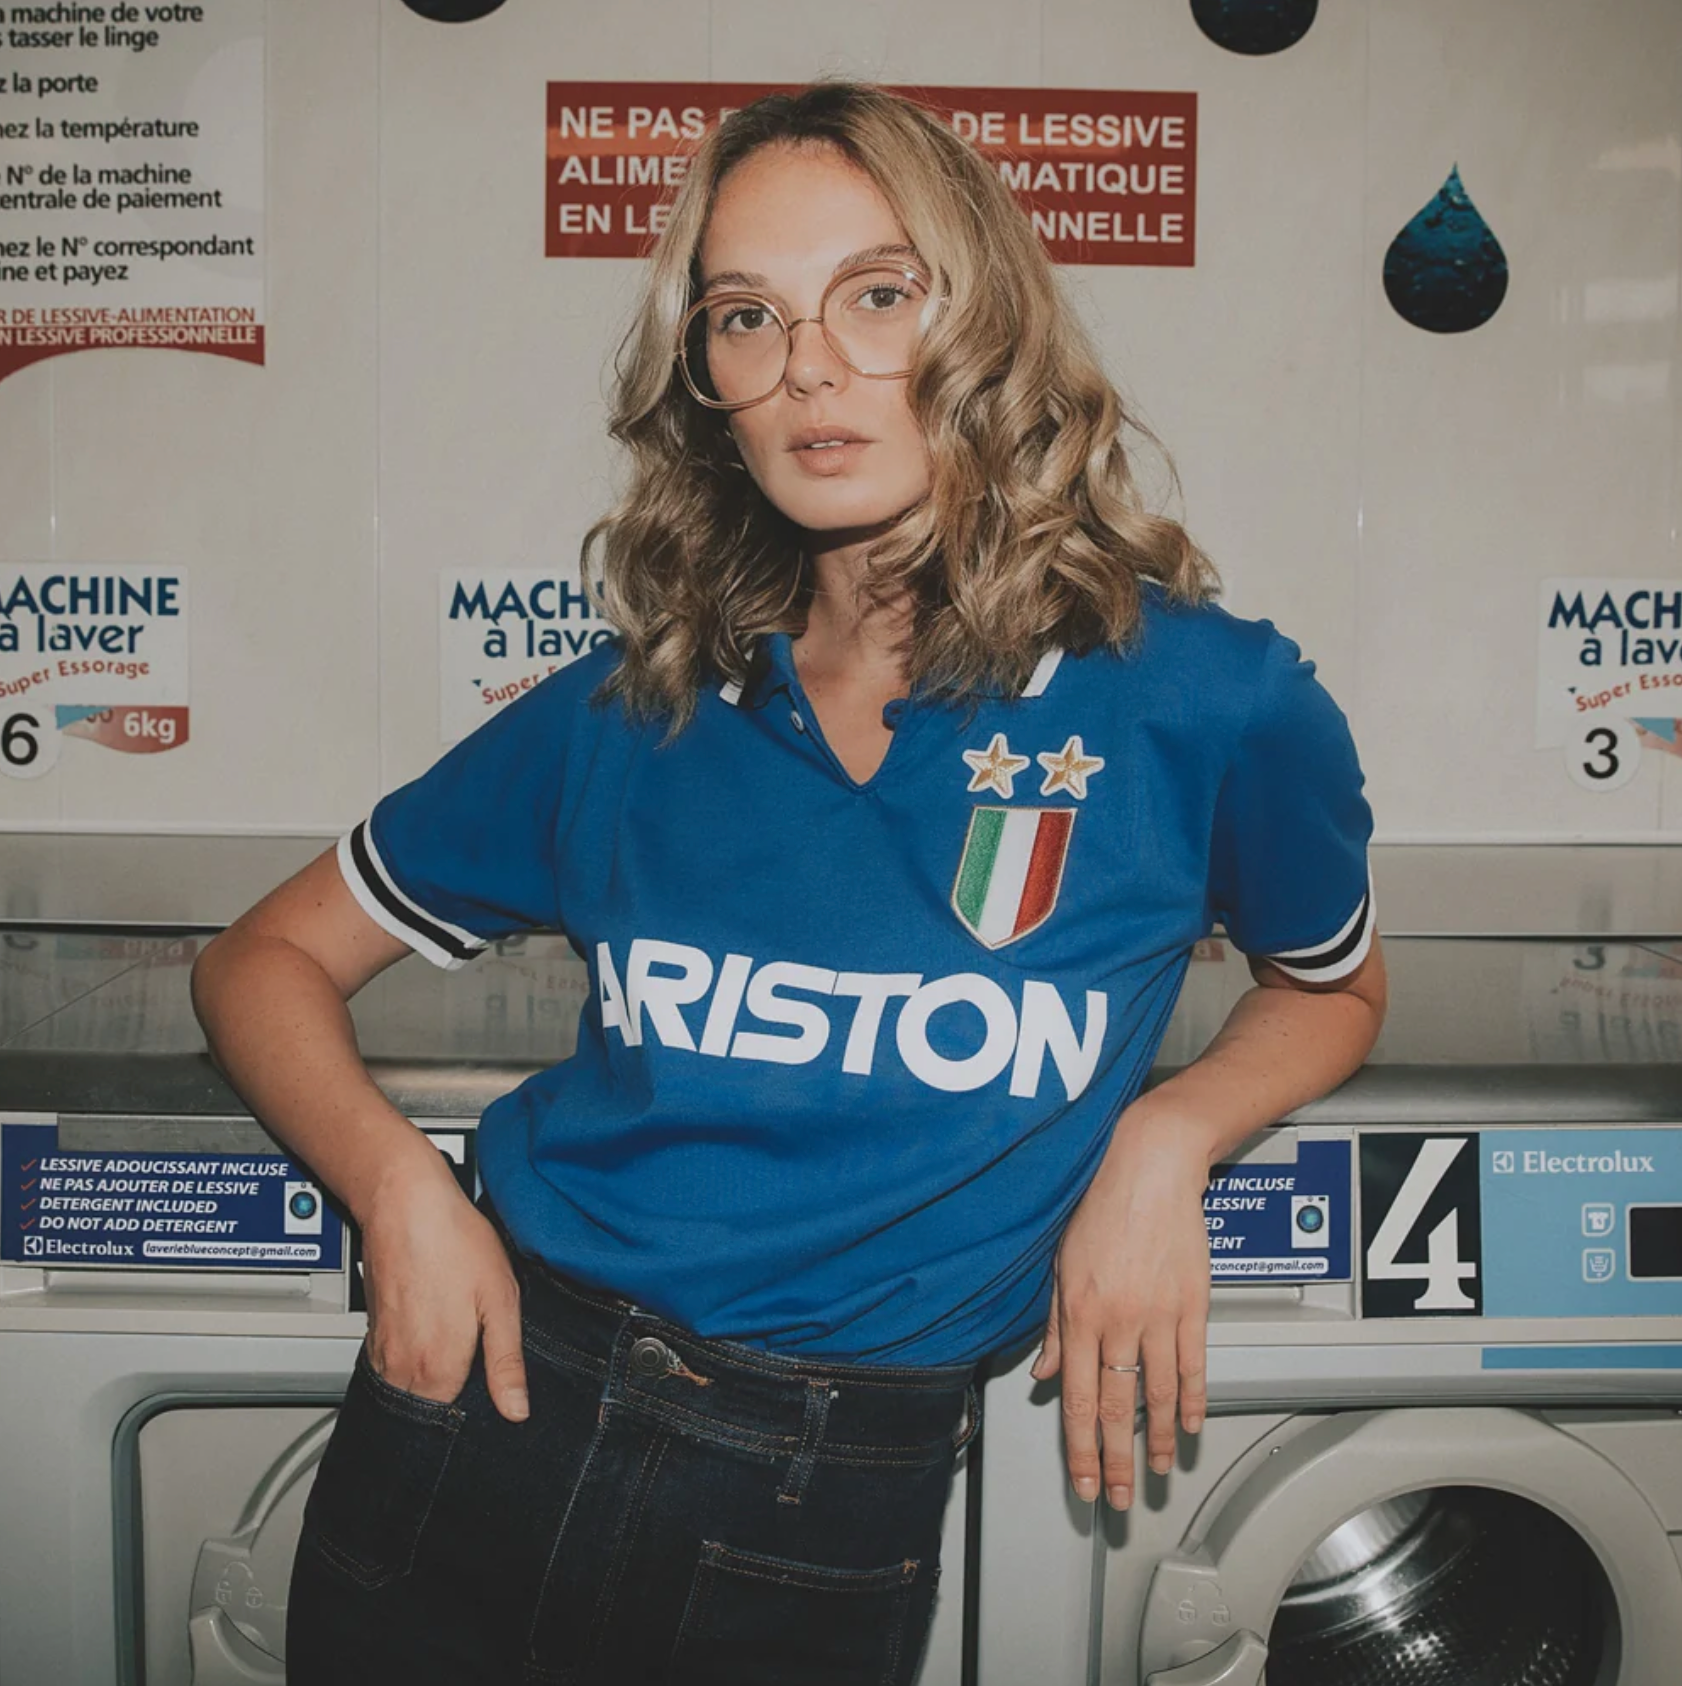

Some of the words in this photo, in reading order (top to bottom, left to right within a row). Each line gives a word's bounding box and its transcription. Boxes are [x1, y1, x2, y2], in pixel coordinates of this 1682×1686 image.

[11, 1, 105, 24] machine
[111, 2, 140, 22] de
[146, 5, 204, 22] votre
[9, 29, 74, 48] tasser
[79, 26, 99, 47] le
[104, 26, 159, 52] linge
[13, 72, 32, 93] la
[38, 74, 99, 98] porte
[36, 117, 54, 138] la
[60, 117, 200, 142] température
[560, 106, 615, 139] NE
[628, 107, 706, 140] PAS
[952, 111, 1006, 144] DE
[1019, 113, 1186, 149] LESSIVE
[39, 164, 67, 185] de
[73, 164, 92, 184] la
[98, 163, 192, 185] machine
[999, 161, 1186, 196] MATIQUE
[82, 189, 111, 208] de
[118, 189, 223, 213] paiement
[560, 204, 612, 235] EN
[36, 236, 56, 257] le
[93, 234, 255, 260] correspondant
[35, 262, 58, 281] et
[63, 264, 129, 286] payez
[12, 308, 36, 325] DE
[17, 327, 87, 346] LESSIVE
[89, 327, 258, 346] PROFESSIONNELLE
[0, 575, 180, 617] ACHINE
[37, 613, 144, 654] laver
[483, 616, 507, 658] à
[1579, 622, 1603, 667] à
[1620, 628, 1682, 667] lav
[57, 659, 150, 680] Essorage
[1575, 681, 1632, 713] Super
[1, 712, 41, 766] 6
[123, 711, 177, 743] 6kg
[1582, 726, 1620, 780] 3
[596, 938, 1108, 1102] ARISTON
[40, 1158, 103, 1174] LESSIVE
[104, 1160, 220, 1176] ADOUCISSANT
[221, 1162, 290, 1177] INCLUSE
[1523, 1150, 1656, 1173] Electrolux
[40, 1178, 62, 1191] NE
[64, 1178, 94, 1192] PAS
[96, 1180, 169, 1194] AJOUTER
[171, 1180, 195, 1194] DE
[196, 1181, 260, 1196] LESSIVE
[1228, 1178, 1296, 1191] INCLUSE
[40, 1197, 135, 1212] DETERGENT
[136, 1199, 218, 1214] INCLUDED
[1203, 1197, 1267, 1211] LESSIVE
[40, 1216, 66, 1231] DO
[67, 1217, 102, 1231] NOT
[103, 1218, 140, 1232] ADD
[143, 1218, 239, 1234] DETERGENT
[1367, 1138, 1477, 1310] 4
[46, 1240, 134, 1257] Electrolux
[146, 1242, 318, 1260] laverieblueconcept@gmail.com
